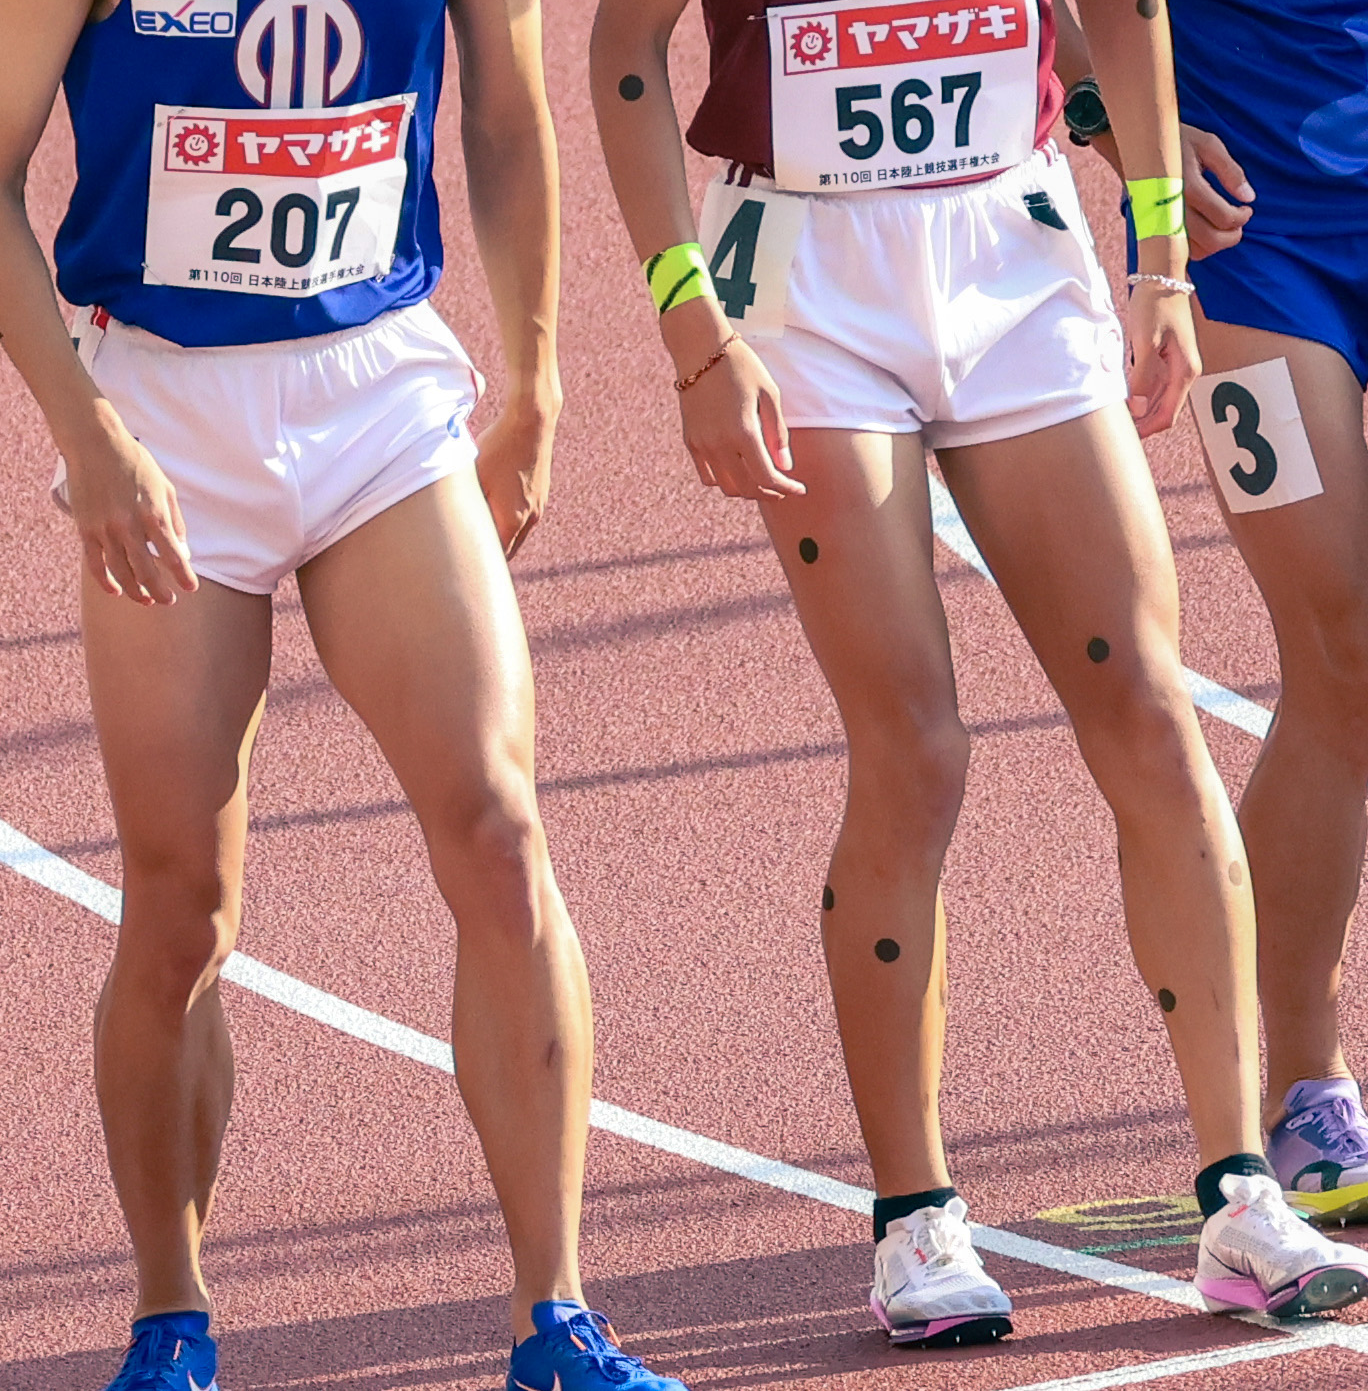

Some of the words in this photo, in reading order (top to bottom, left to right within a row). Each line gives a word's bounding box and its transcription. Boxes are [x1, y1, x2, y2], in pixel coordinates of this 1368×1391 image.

[134, 0, 234, 34] EXEO
[847, 4, 1017, 55] ヤマザキ
[834, 70, 983, 161] 567
[236, 118, 393, 167] ヤマザキ
[818, 169, 873, 187] 第110回
[876, 151, 1001, 182] 日本陸上競技選手権大会
[211, 186, 361, 269] 207
[188, 267, 243, 285] 第110回
[708, 199, 767, 320] 4
[1211, 381, 1278, 497] 3
